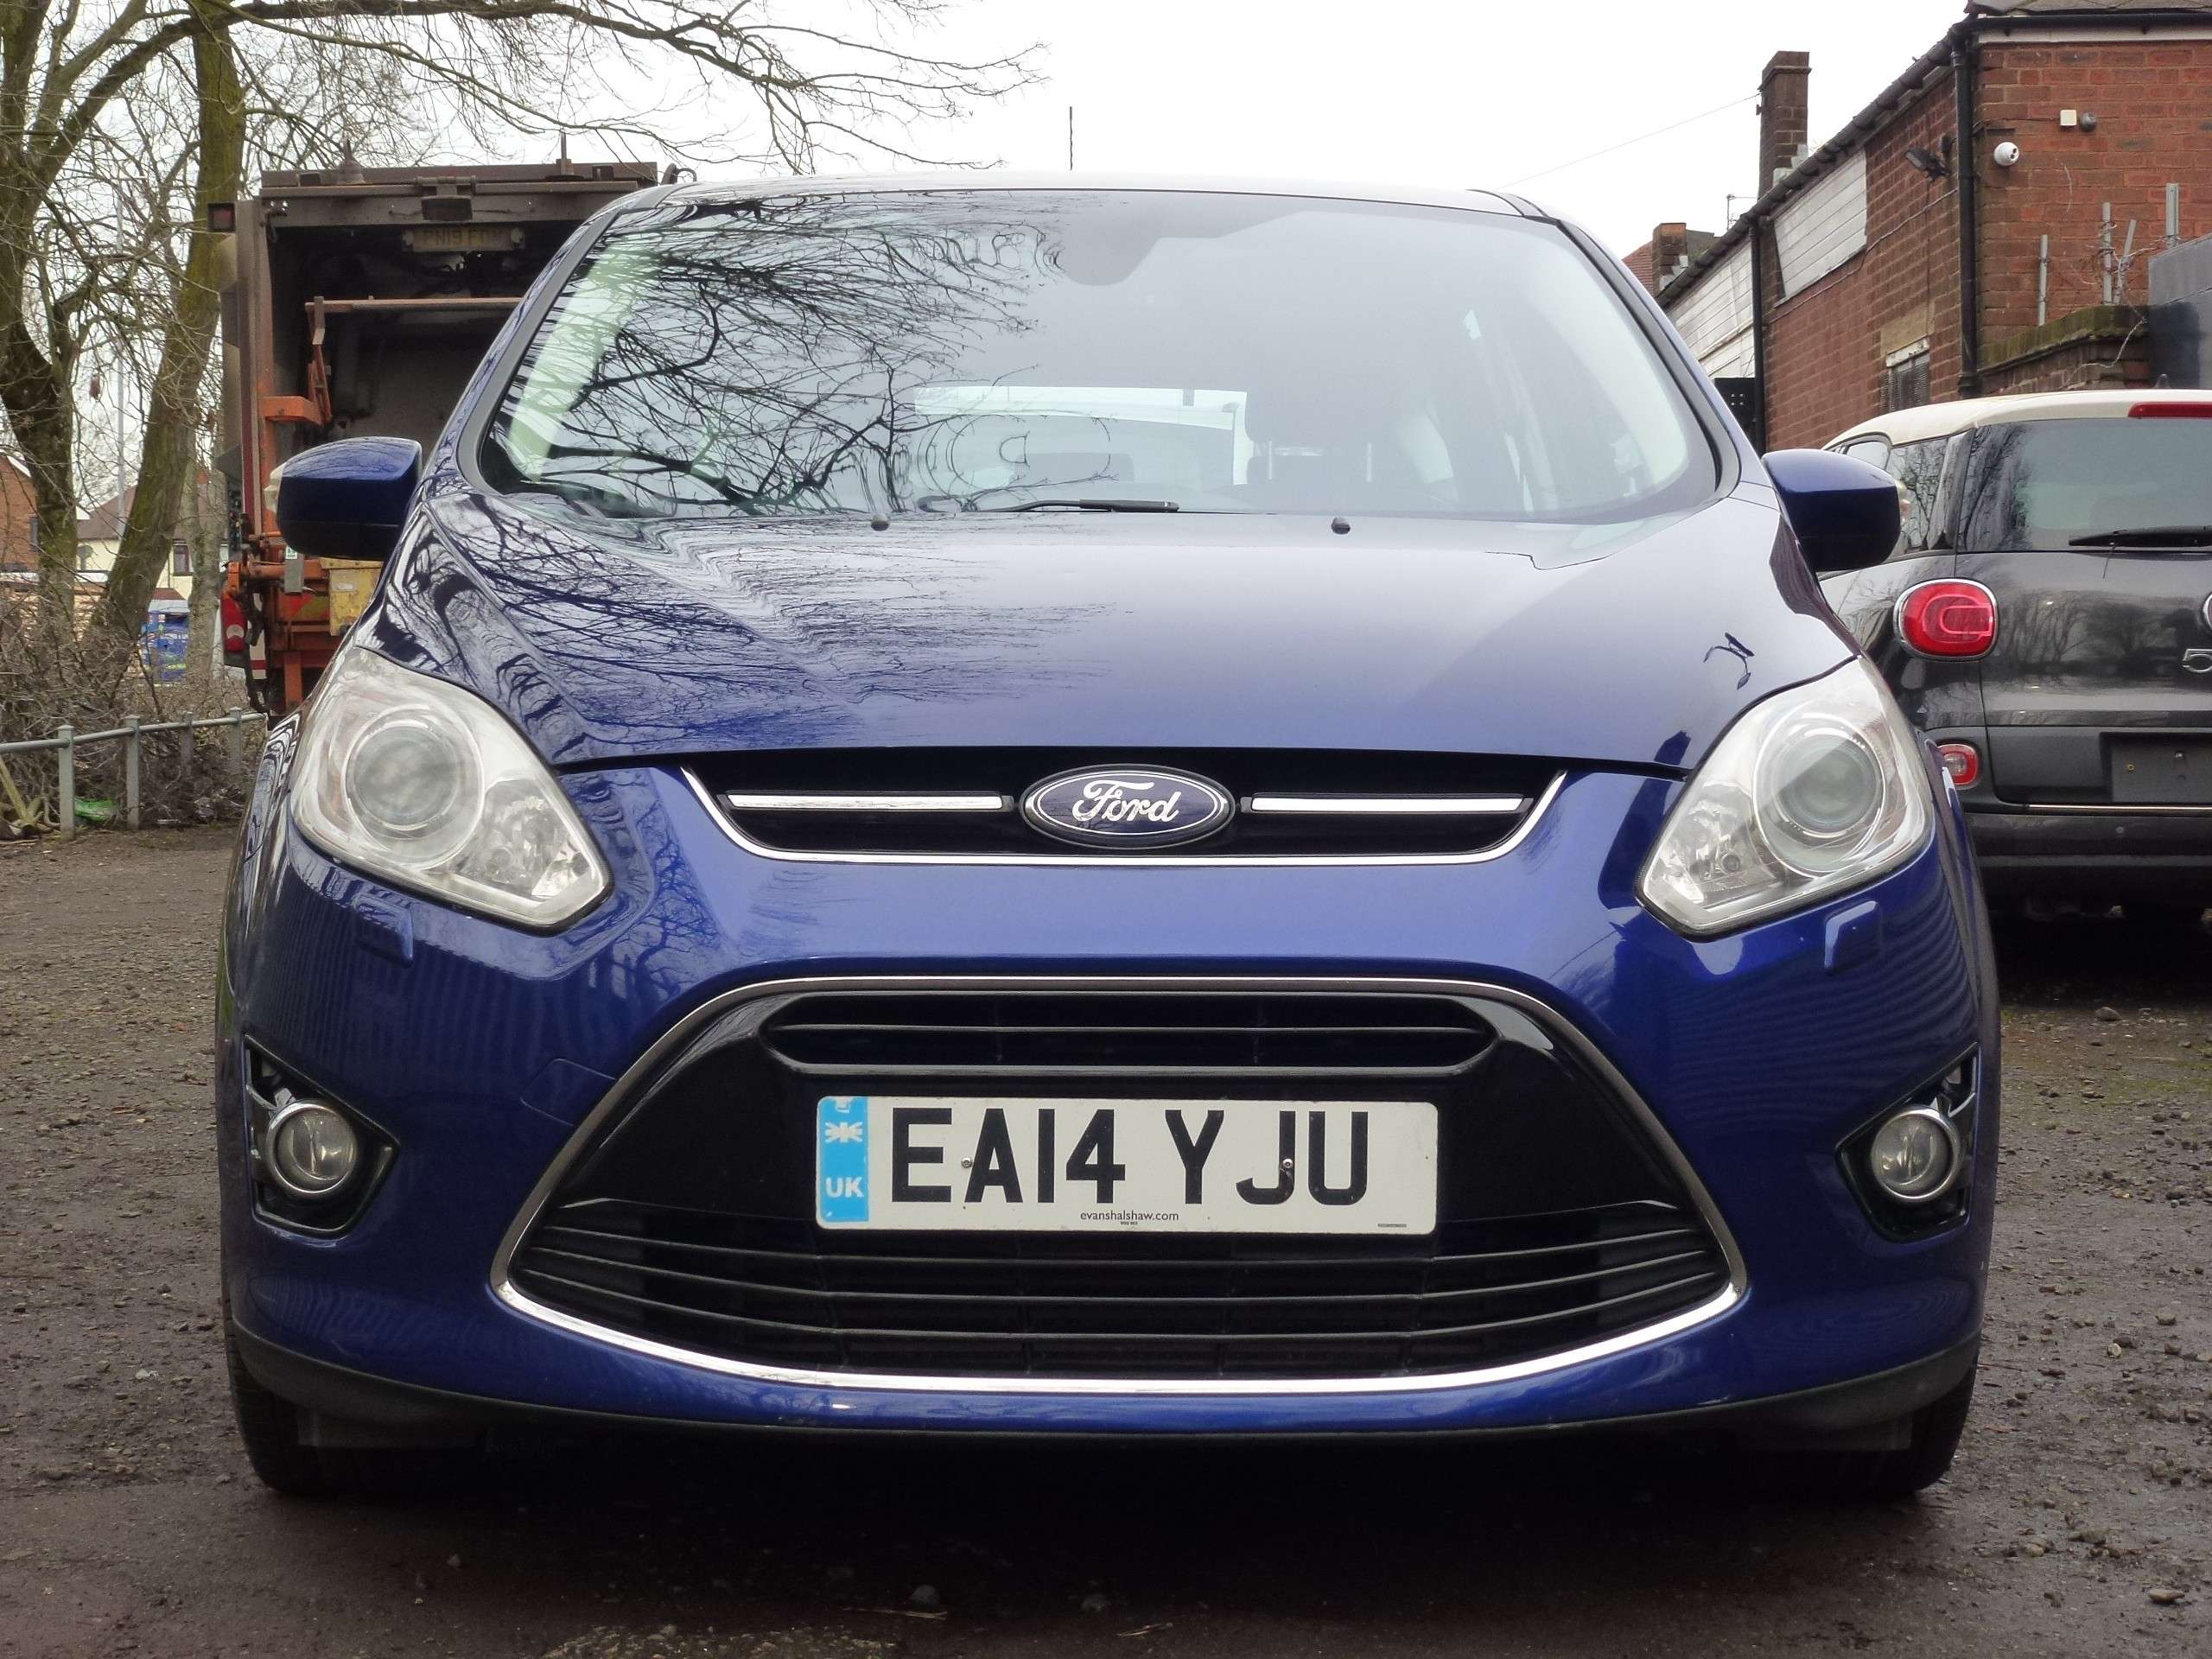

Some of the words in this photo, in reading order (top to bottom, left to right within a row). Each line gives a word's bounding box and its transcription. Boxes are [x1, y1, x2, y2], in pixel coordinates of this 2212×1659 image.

[1071, 779, 1181, 822] Ford
[892, 1107, 1126, 1204] EA14
[1165, 1109, 1369, 1206] YJU
[826, 1177, 864, 1198] UK
[1080, 1210, 1179, 1221] evanshalshaw.com
